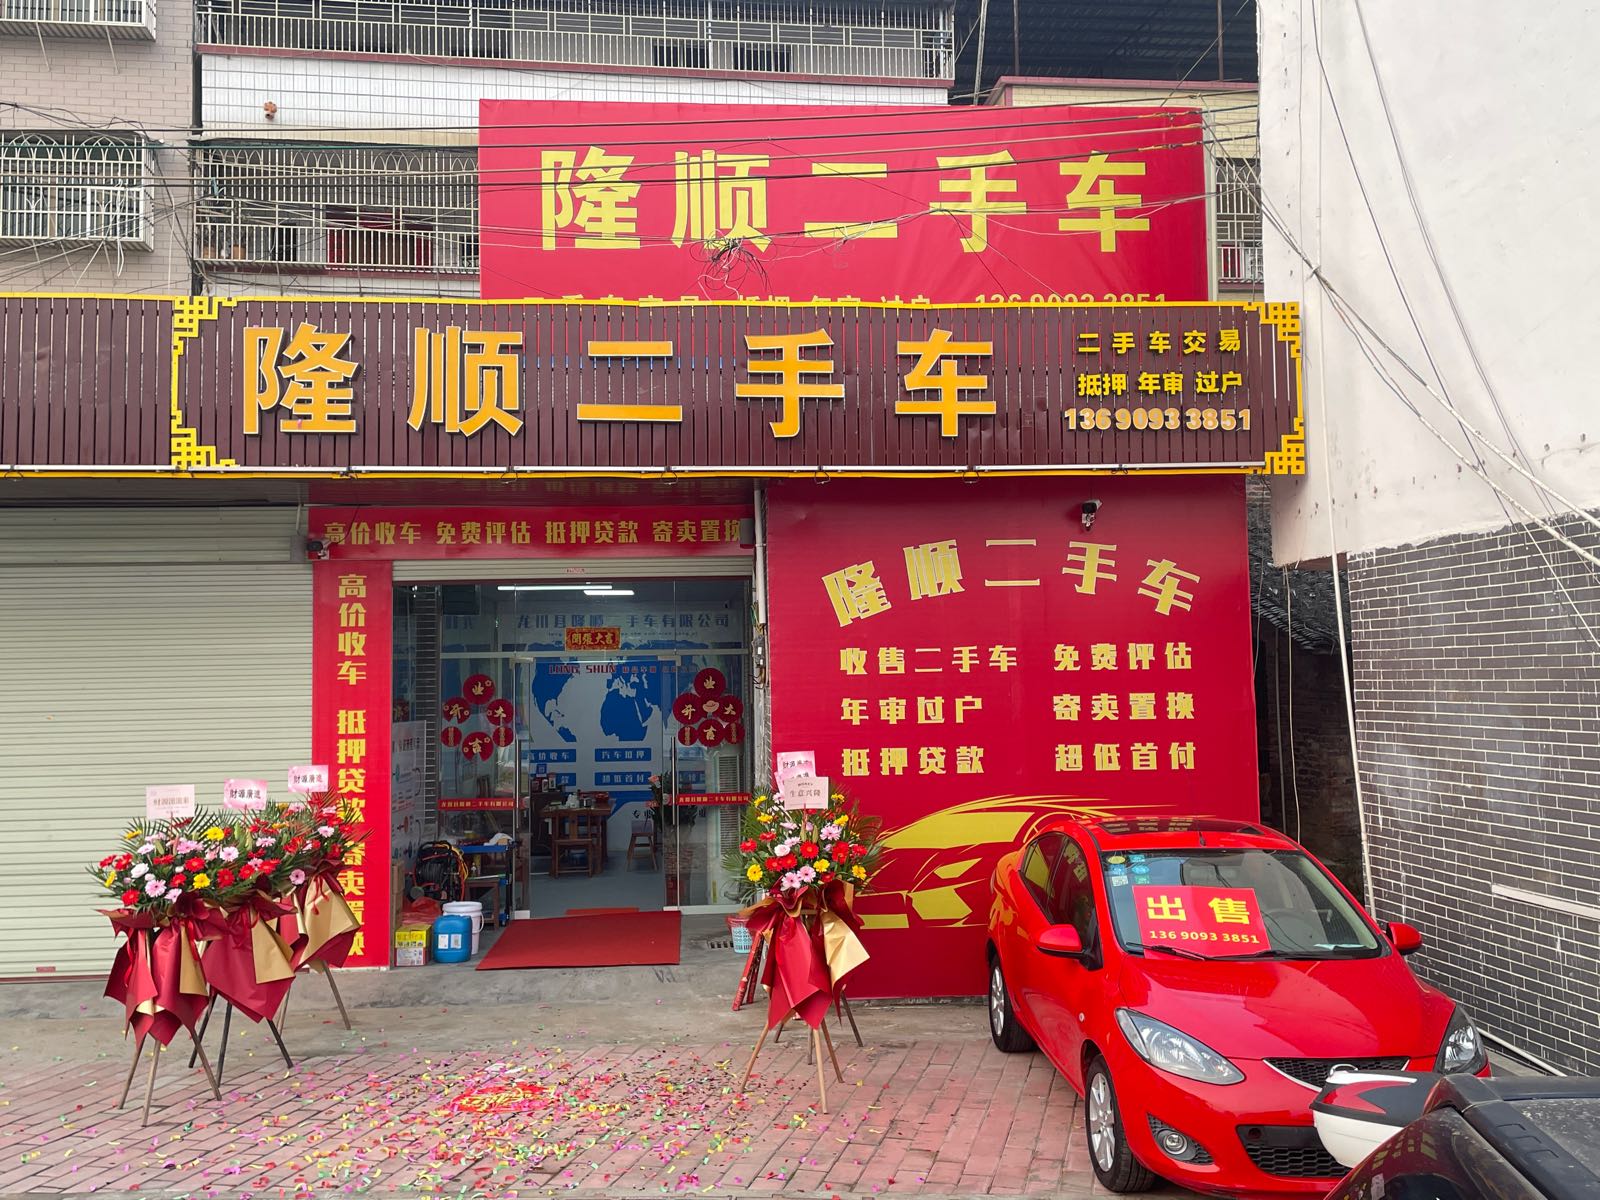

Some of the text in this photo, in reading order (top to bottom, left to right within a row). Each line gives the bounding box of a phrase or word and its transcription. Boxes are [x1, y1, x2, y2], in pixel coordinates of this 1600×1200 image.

[541, 146, 1150, 253] 隆顺二手车
[1077, 328, 1242, 354] 二手车交易
[243, 322, 997, 438] 隆顺二手车
[1078, 371, 1243, 396] 抵押 年审 过户
[1064, 408, 1251, 430] 136 9093 3851
[324, 521, 422, 545] 高价收车
[436, 521, 531, 545] 免费评估
[545, 520, 639, 544] 抵押贷款
[821, 538, 1201, 627] 隆顺二手车
[336, 573, 367, 686] 高价收车
[585, 663, 618, 674] SHUN
[840, 641, 1193, 676] 收售二手车 免费评估
[841, 692, 1196, 726] 年审过户 寄卖置换
[336, 709, 366, 823] 抵押贷款
[841, 741, 1197, 777] 抵押贷款 超低首付
[1146, 895, 1250, 925] 出售
[1149, 930, 1260, 944] 136 9093 3851
